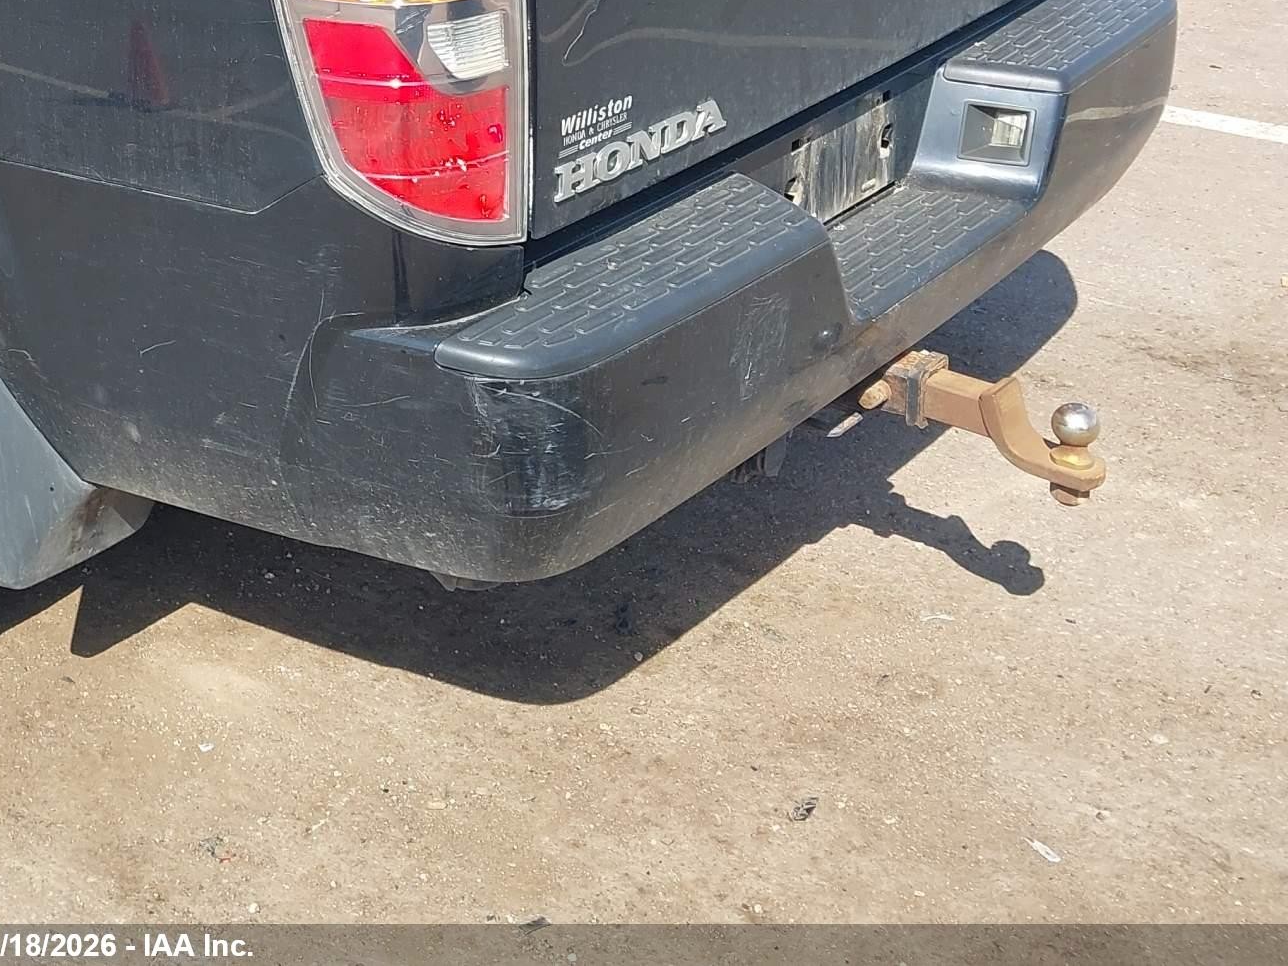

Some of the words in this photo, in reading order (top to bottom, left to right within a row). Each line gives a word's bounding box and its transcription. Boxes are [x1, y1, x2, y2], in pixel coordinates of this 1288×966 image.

[562, 95, 633, 136] Williston
[563, 131, 586, 146] HONDA
[589, 127, 595, 136] &
[597, 113, 627, 131] CHRYSLER
[554, 99, 727, 203] HONDA
